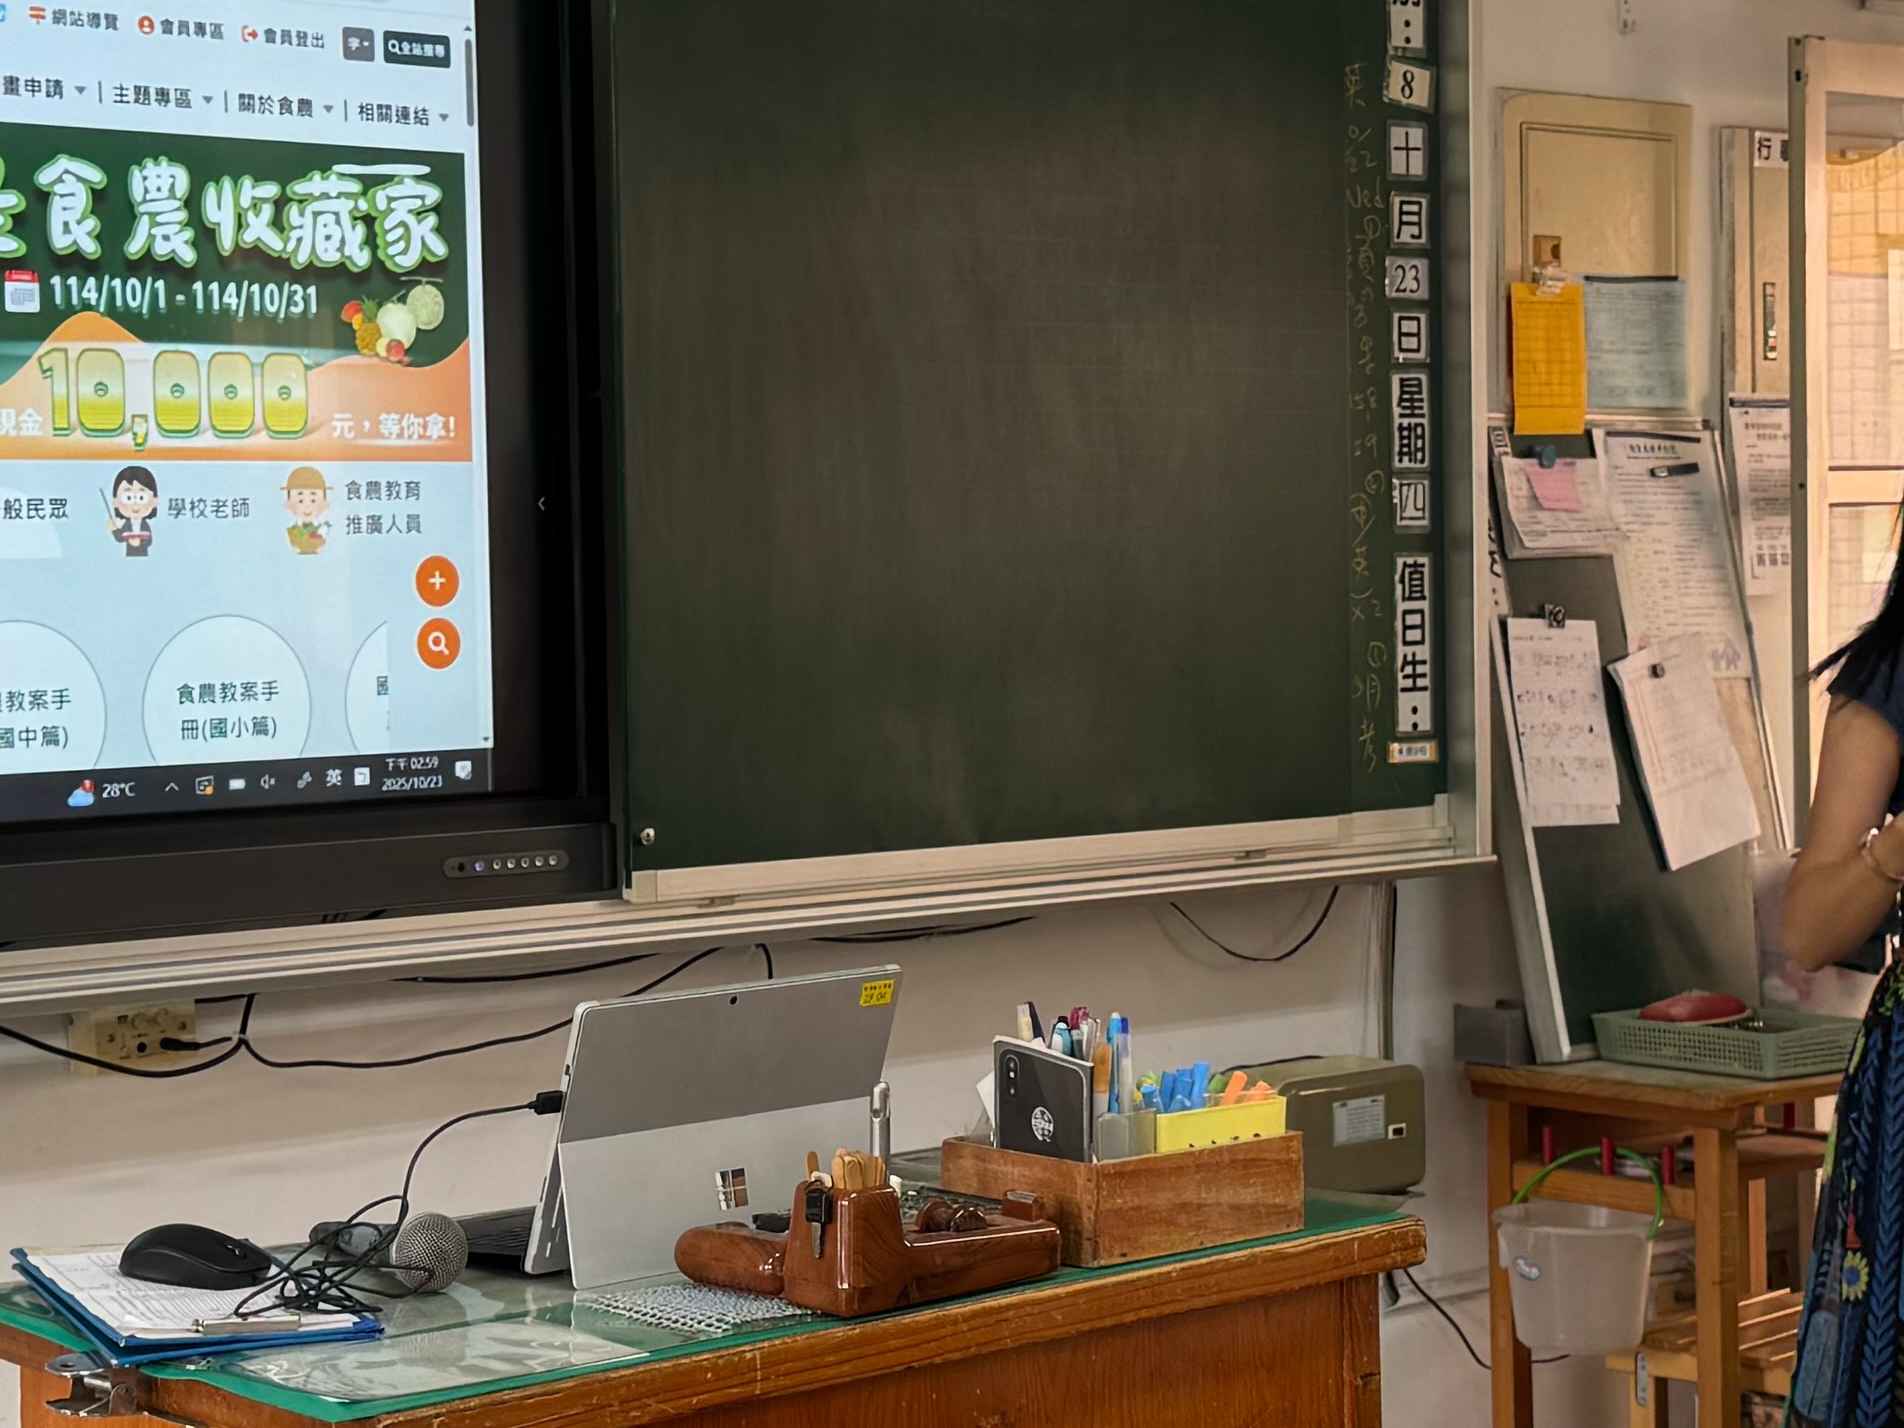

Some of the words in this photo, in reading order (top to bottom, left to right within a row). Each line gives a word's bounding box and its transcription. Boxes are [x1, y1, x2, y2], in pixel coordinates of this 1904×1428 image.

[51, 7, 120, 32] 網站導覽
[159, 17, 225, 41] 會員專區
[263, 26, 326, 49] 會員登出
[112, 82, 193, 110] 主題專區
[1400, 69, 1415, 100] 8
[237, 92, 315, 119] 關於食農
[357, 101, 431, 127] 相關連結
[1393, 263, 1422, 294] 23
[50, 274, 168, 318] 114/10/1
[191, 280, 319, 320] 114/10/31
[38, 347, 310, 450] 10,000
[344, 479, 423, 502] 食農教育
[166, 496, 252, 521] 學校老師
[345, 512, 424, 537] 推廣人員
[175, 680, 281, 706] 食農教案手
[179, 716, 279, 742] 冊(國小篇)
[101, 781, 136, 799] 28°C
